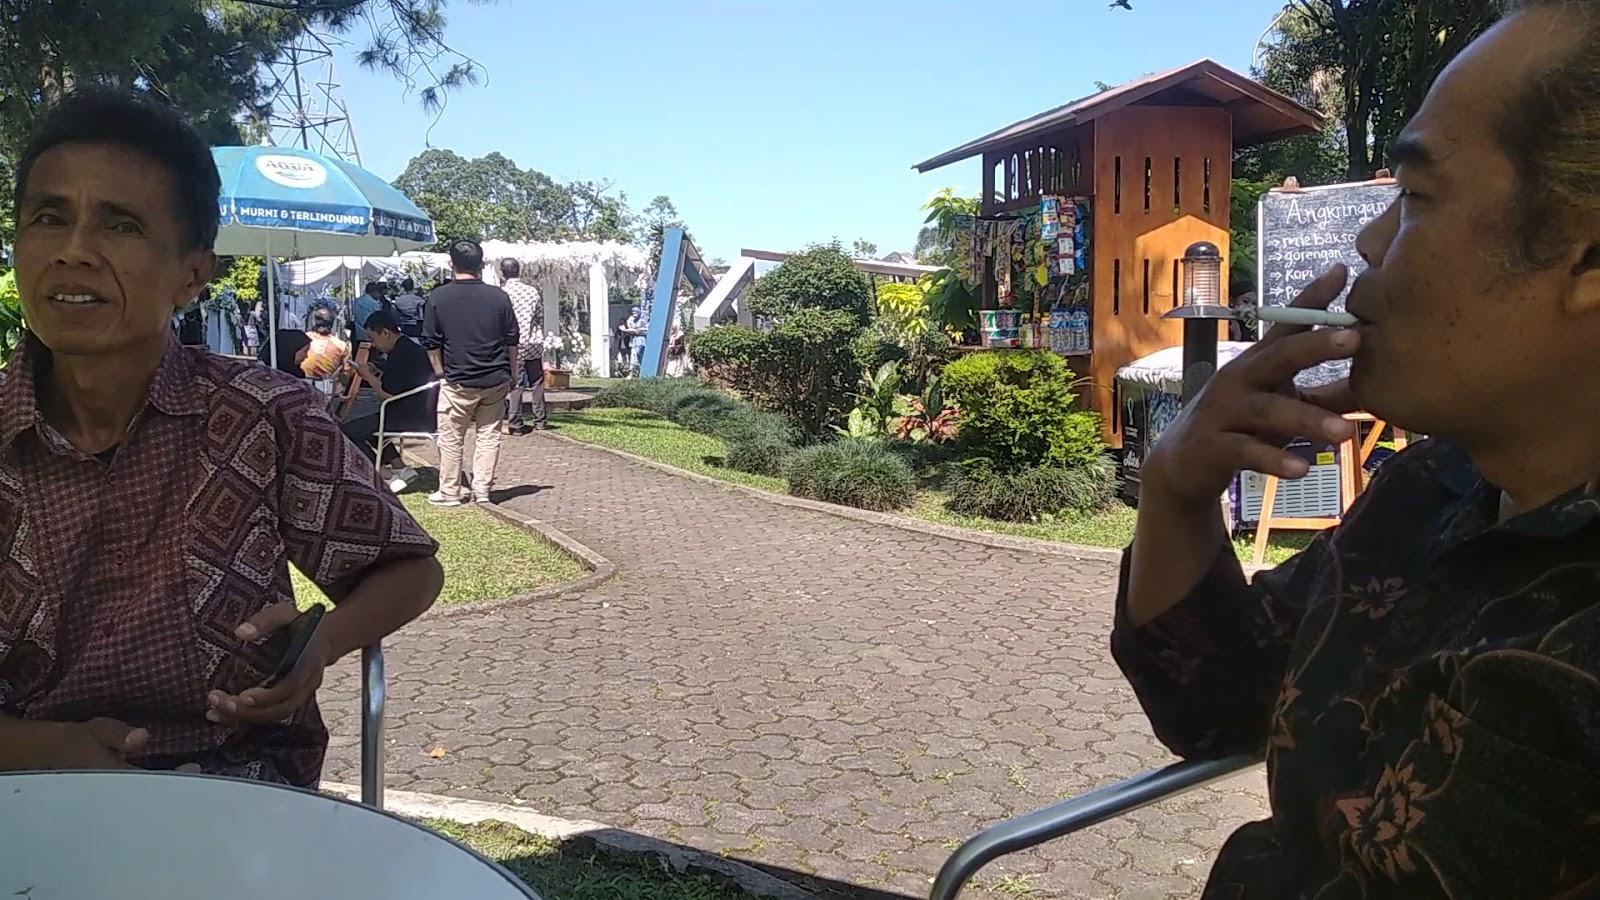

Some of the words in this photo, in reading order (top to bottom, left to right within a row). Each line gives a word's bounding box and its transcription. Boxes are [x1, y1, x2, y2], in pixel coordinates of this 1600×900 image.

[266, 160, 315, 172] AQUA
[240, 207, 278, 218] MURNI
[280, 210, 289, 220] &
[290, 210, 365, 225] TERLINDUNGI
[1286, 199, 1387, 230] Angkringan
[1313, 233, 1356, 246] bakso
[1283, 248, 1342, 268] gorengan
